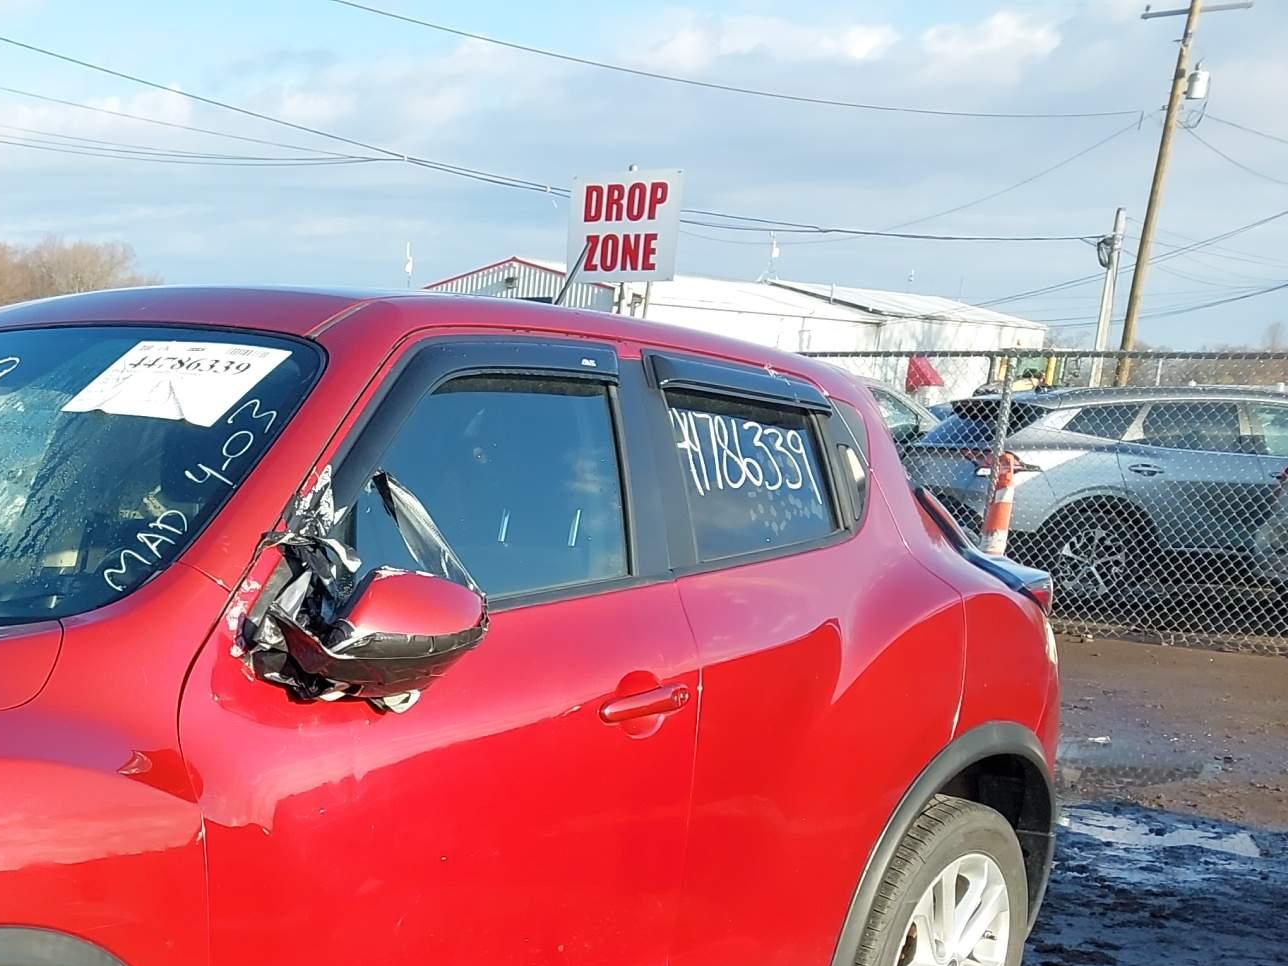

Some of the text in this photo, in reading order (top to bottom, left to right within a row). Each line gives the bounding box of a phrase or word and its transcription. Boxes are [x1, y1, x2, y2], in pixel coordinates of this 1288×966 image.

[584, 181, 669, 223] DROP
[583, 233, 658, 272] ZONE
[128, 355, 252, 376] 44786339
[103, 509, 188, 592] MAD
[184, 399, 277, 489] 4-03
